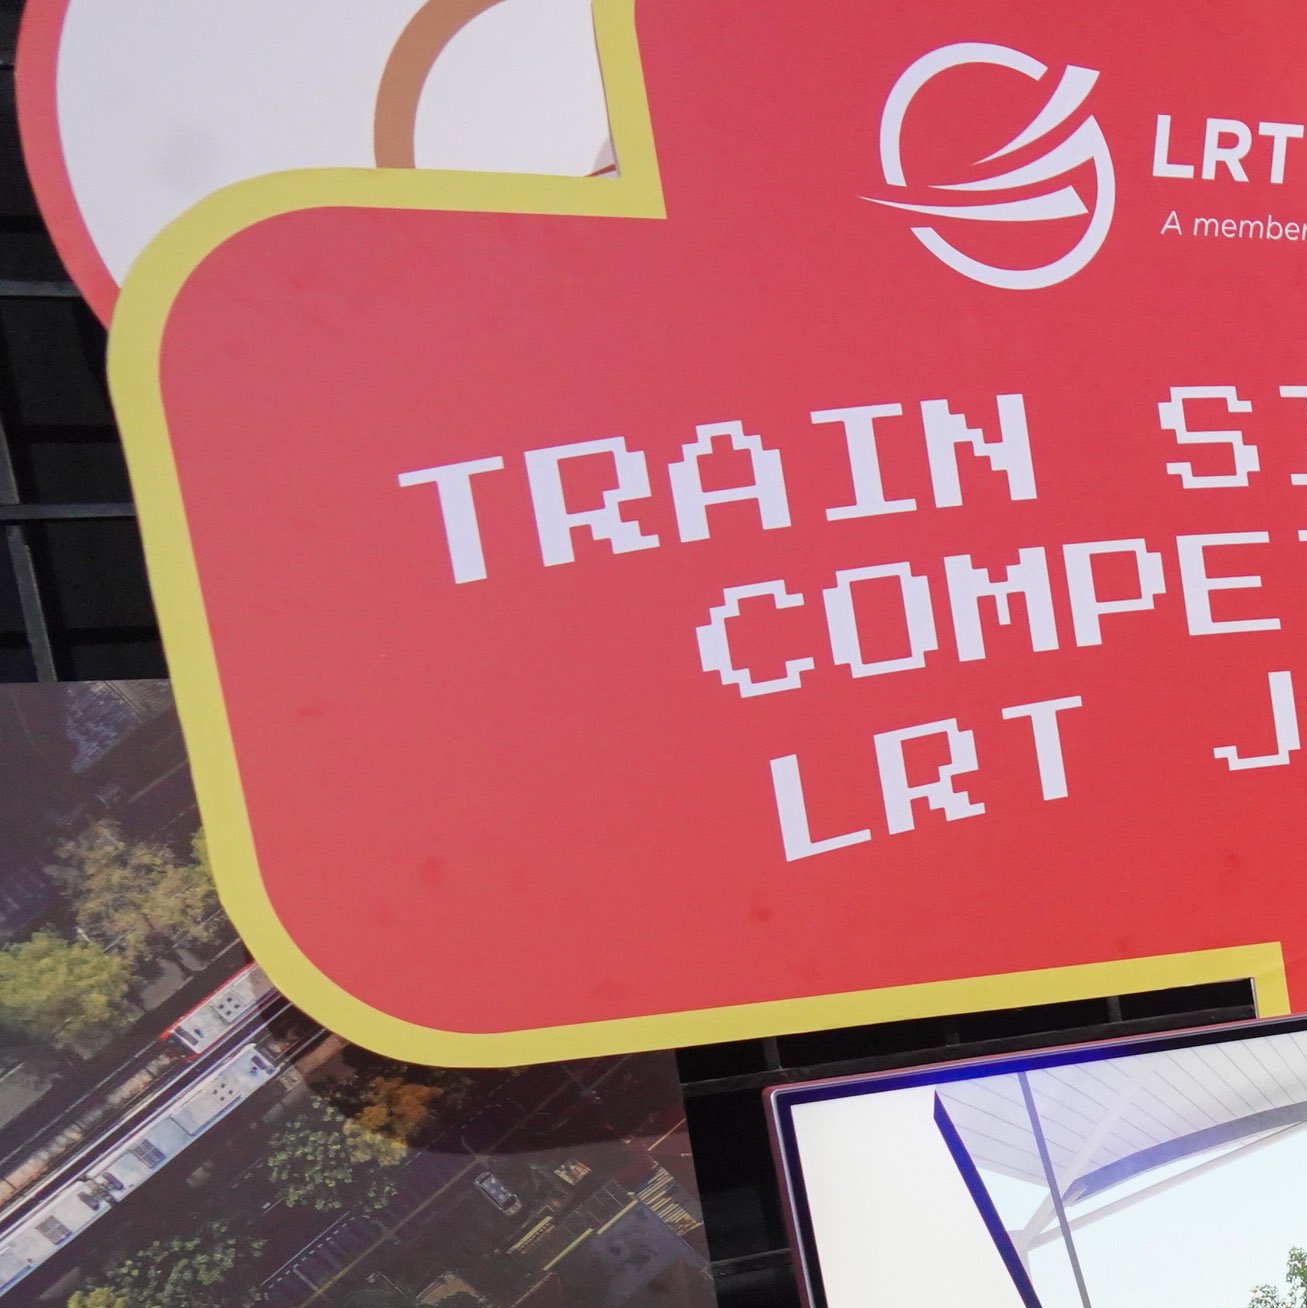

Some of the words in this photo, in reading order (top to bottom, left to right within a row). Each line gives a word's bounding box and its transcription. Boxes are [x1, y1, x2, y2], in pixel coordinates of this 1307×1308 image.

[1152, 114, 1304, 184] LRT
[1161, 210, 1182, 235] A
[398, 394, 1037, 584] TRAIN
[770, 695, 1083, 861] LRT
